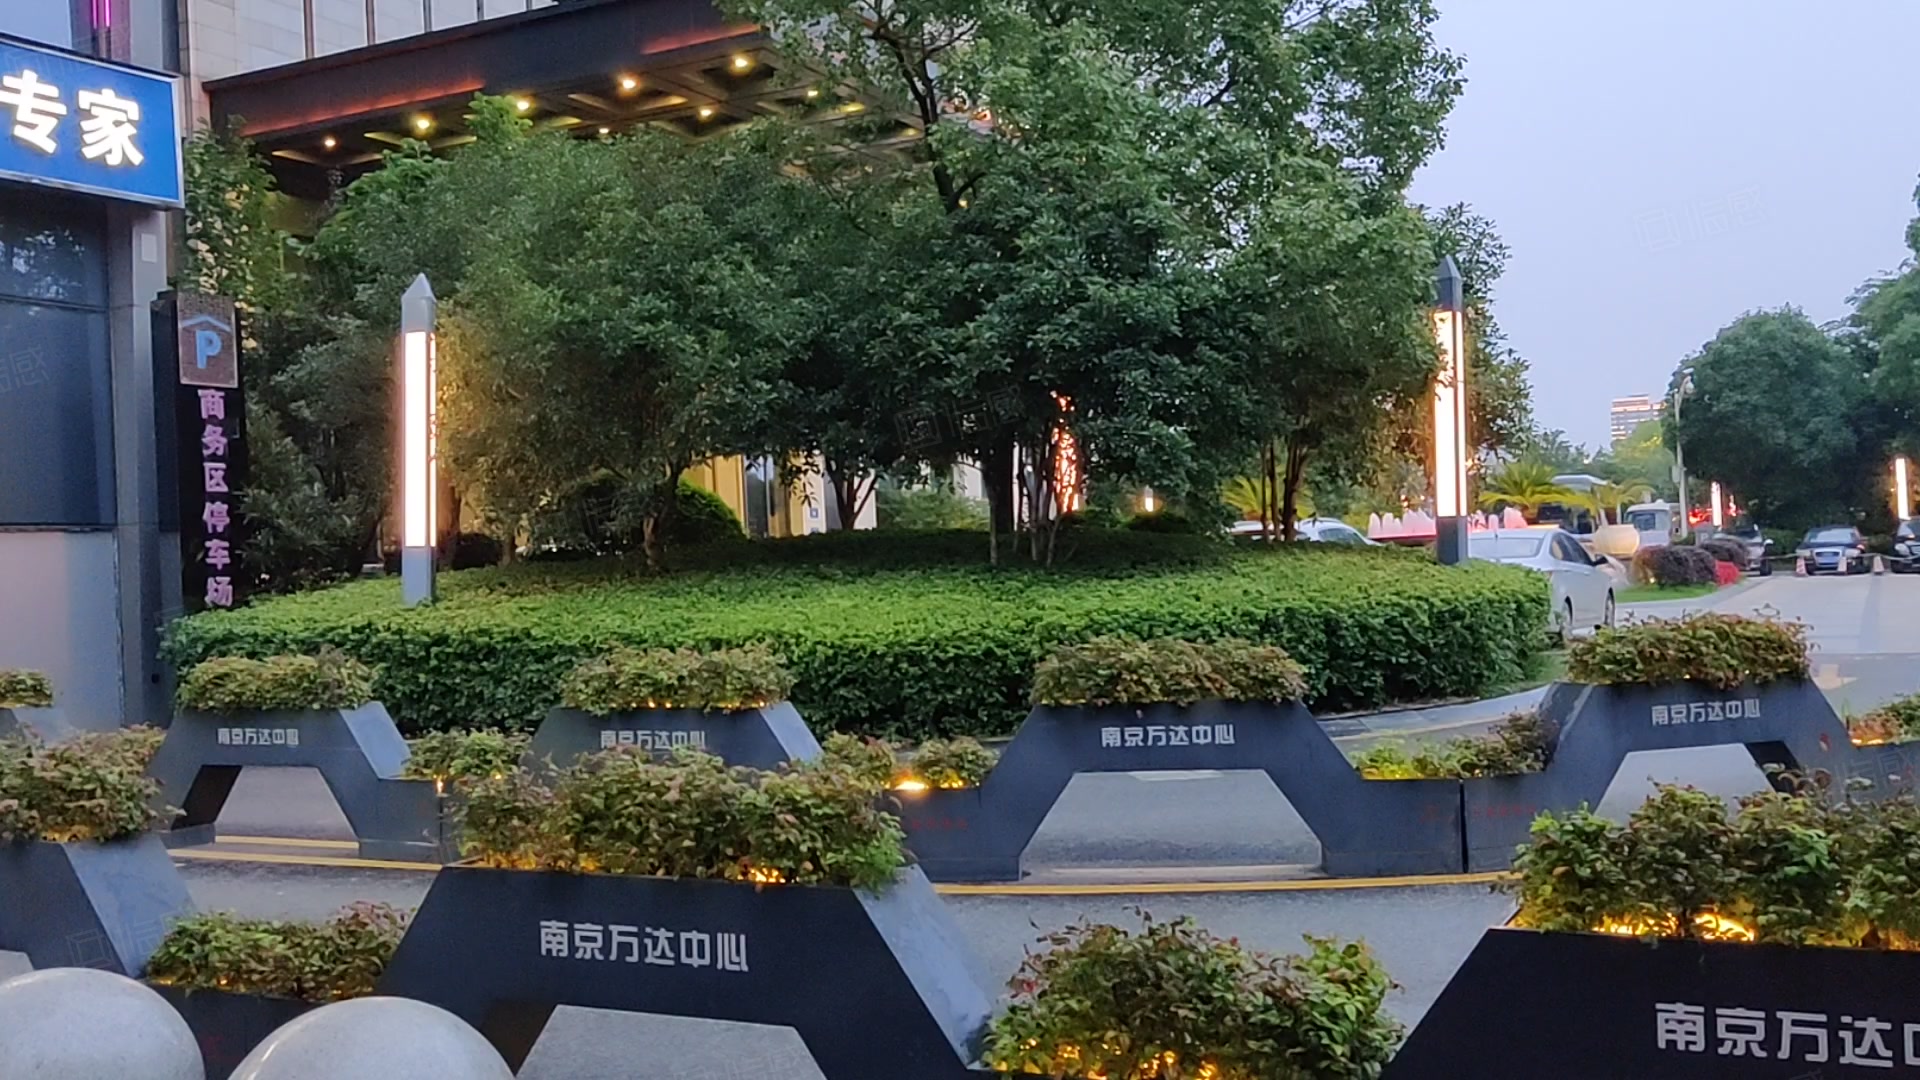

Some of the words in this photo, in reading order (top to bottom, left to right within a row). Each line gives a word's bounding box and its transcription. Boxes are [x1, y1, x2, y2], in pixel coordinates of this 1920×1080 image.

[0, 69, 144, 166] 专家
[196, 330, 222, 369] P
[198, 389, 233, 607] 商务区停车场
[1651, 699, 1760, 726] 南京万达中心
[217, 728, 299, 746] 南京万达中心
[600, 730, 706, 750] 南京万达中心
[1101, 724, 1236, 747] 南京万达中心
[539, 920, 749, 972] 南京万达中心
